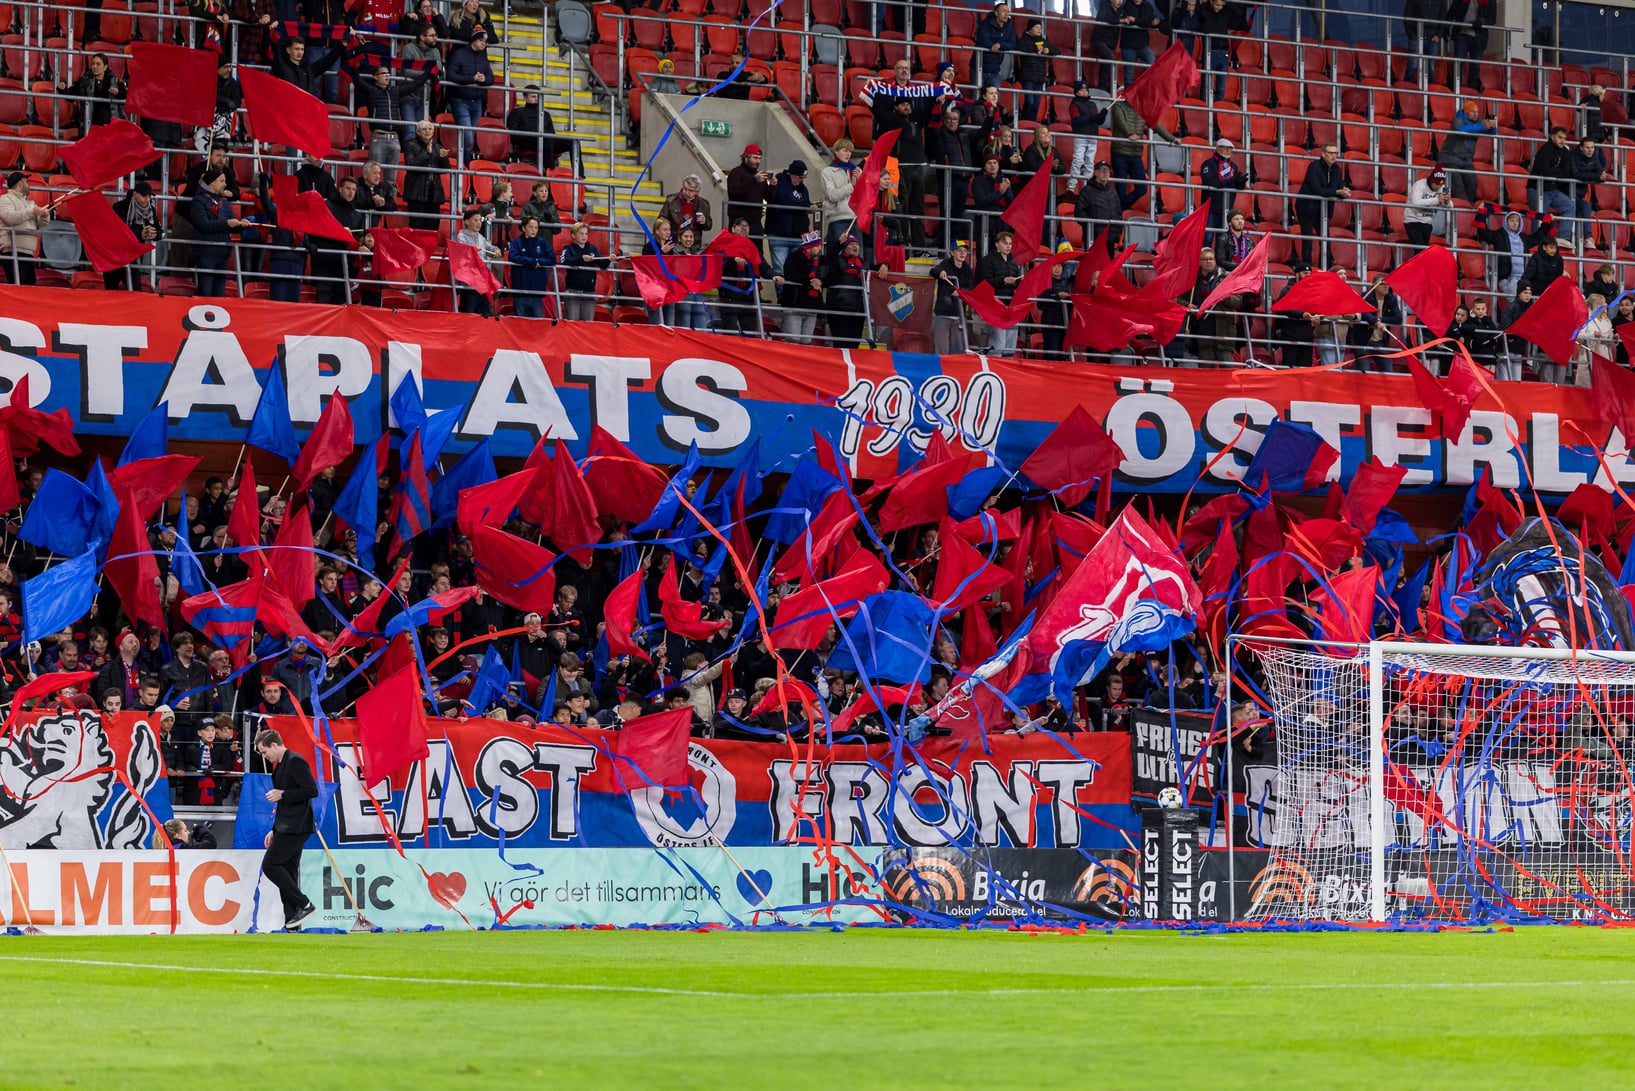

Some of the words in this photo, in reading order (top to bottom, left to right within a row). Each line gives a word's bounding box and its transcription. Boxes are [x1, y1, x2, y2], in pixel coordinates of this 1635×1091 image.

[836, 370, 1006, 457] 1930
[1136, 722, 1212, 758] FRIHET
[331, 736, 597, 845] EAST
[767, 759, 1095, 847] FRONT
[1137, 752, 1215, 788] ULTRAS
[0, 860, 241, 926] LMEC
[323, 863, 395, 911] Hic
[555, 879, 590, 903] det
[595, 880, 722, 903] tillsammans
[1144, 829, 1159, 919] SELECT
[1172, 829, 1192, 920] SELECT
[1572, 910, 1630, 920] KNCK
